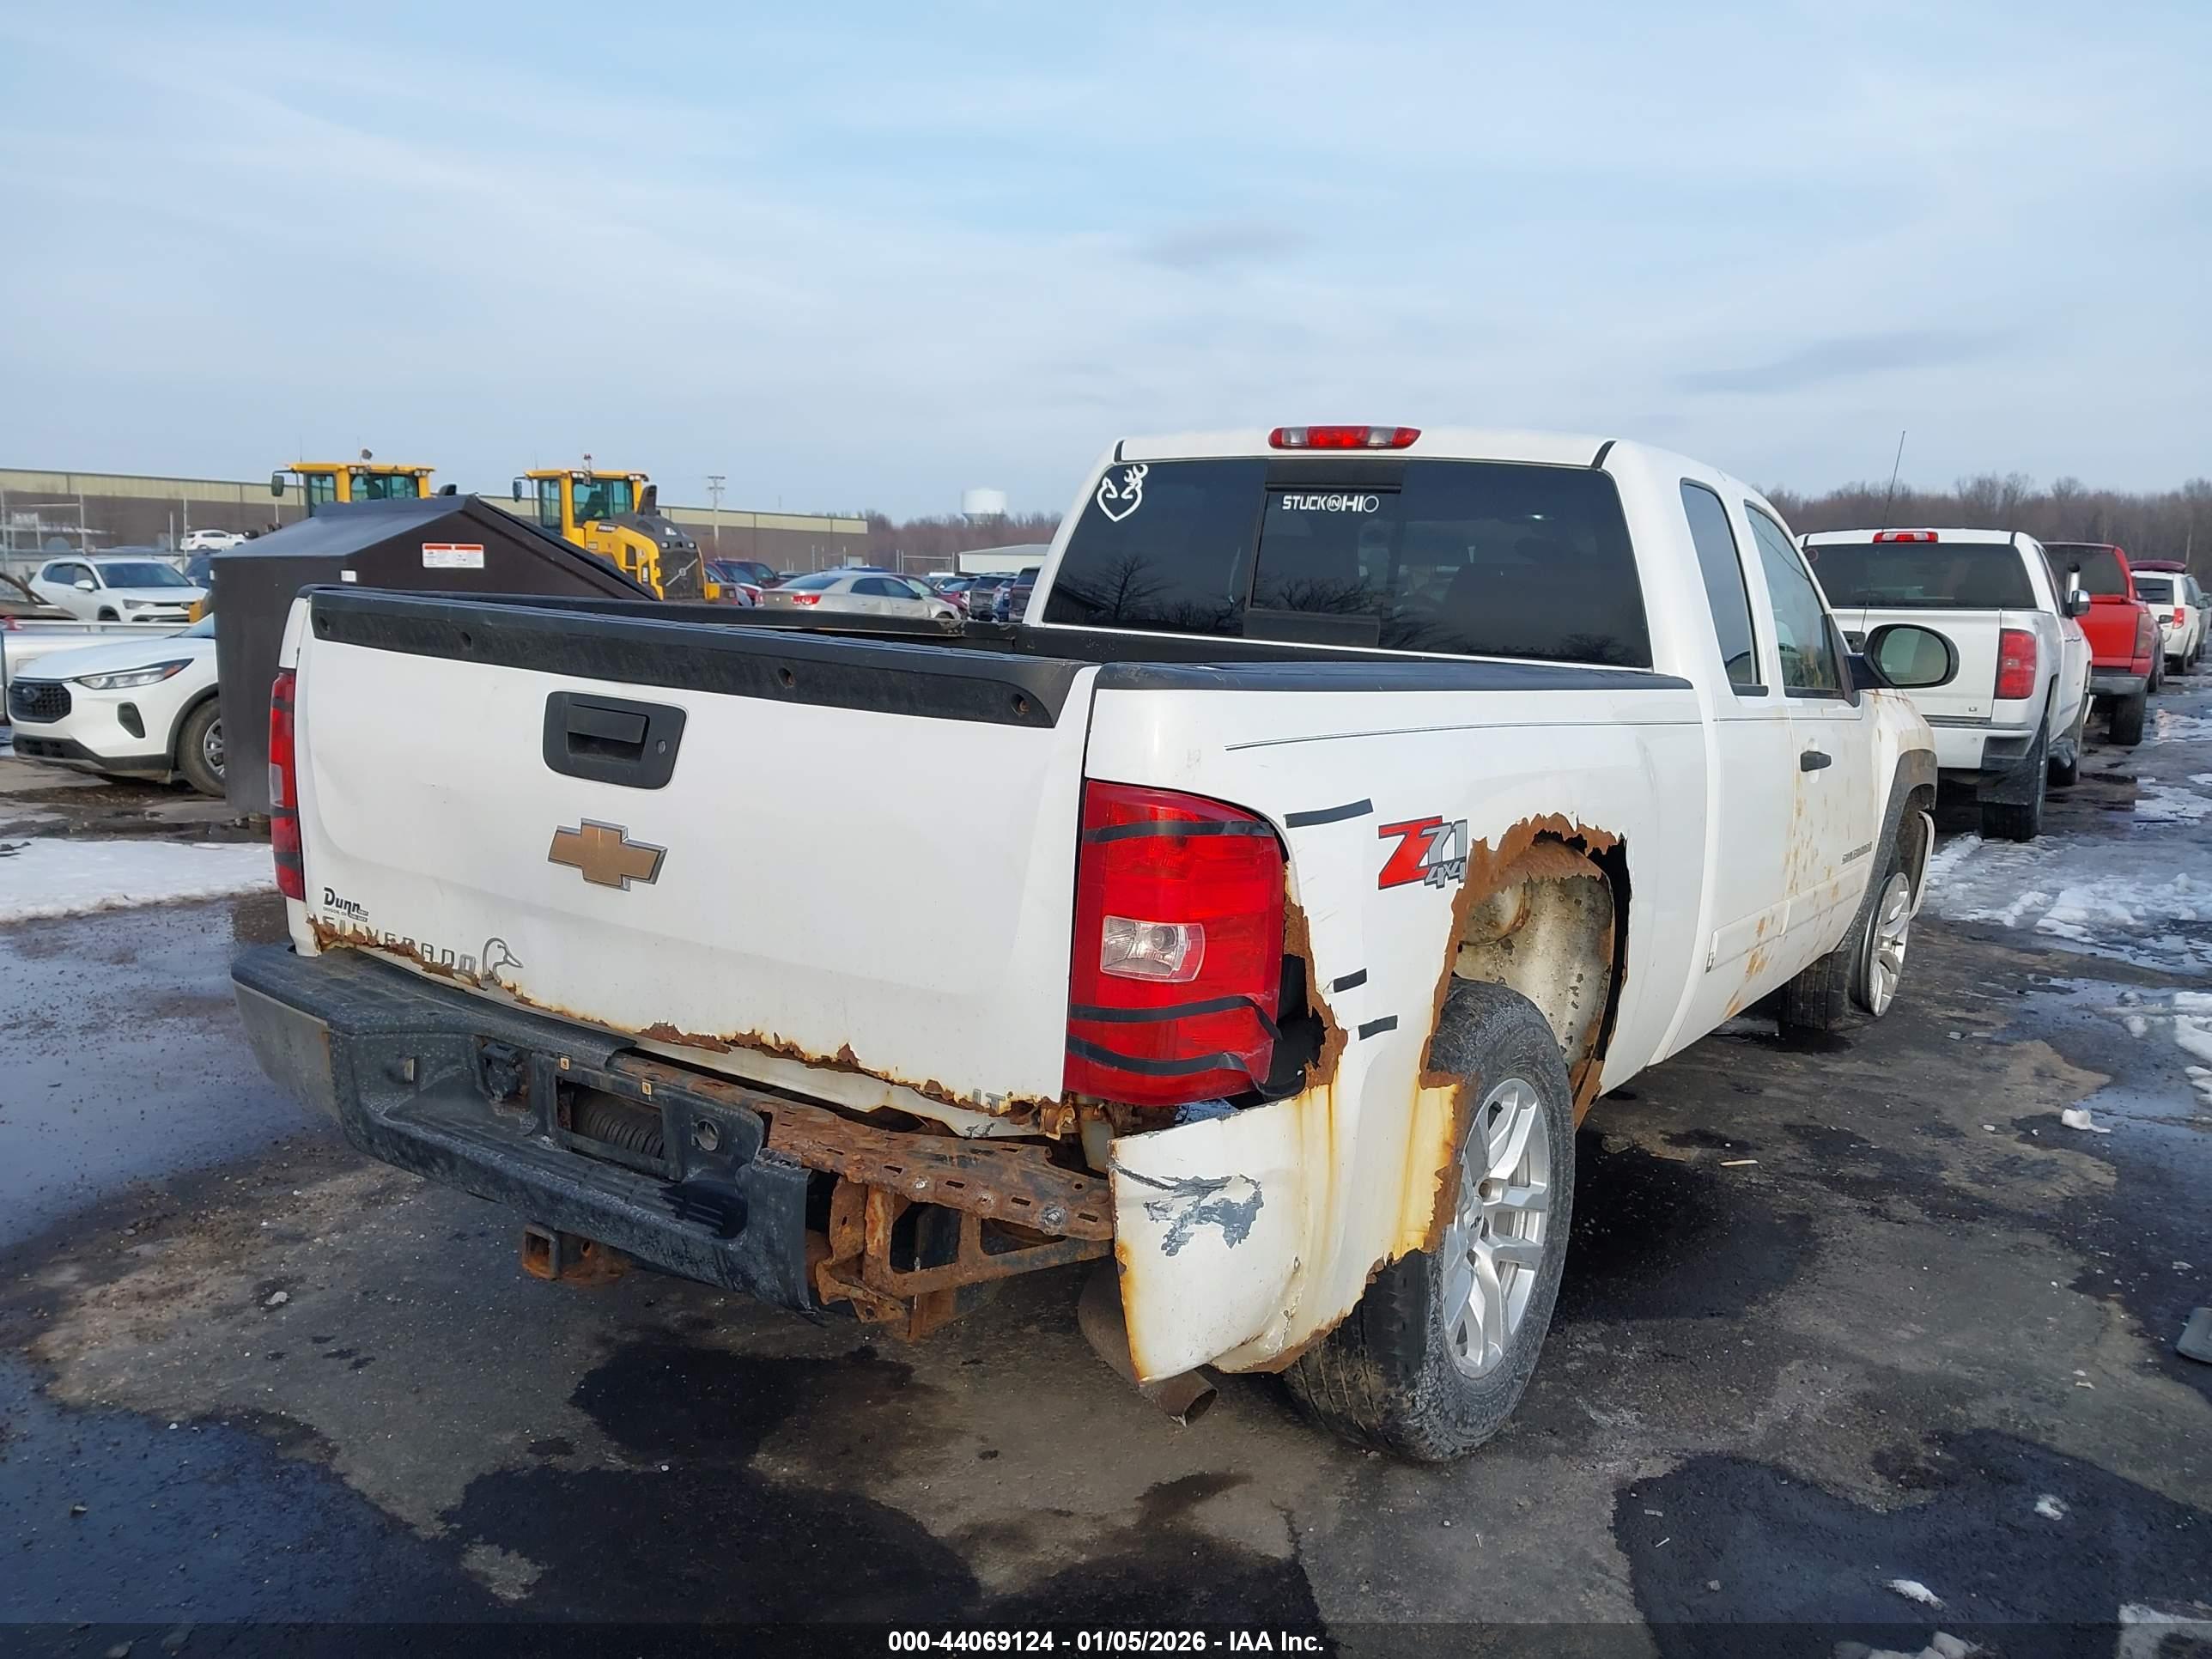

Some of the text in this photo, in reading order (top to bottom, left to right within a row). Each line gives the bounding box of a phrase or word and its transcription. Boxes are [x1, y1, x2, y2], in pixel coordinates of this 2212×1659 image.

[1282, 495, 1328, 511] STUCK
[1378, 816, 1468, 890] Z71
[323, 886, 361, 917] Dunn
